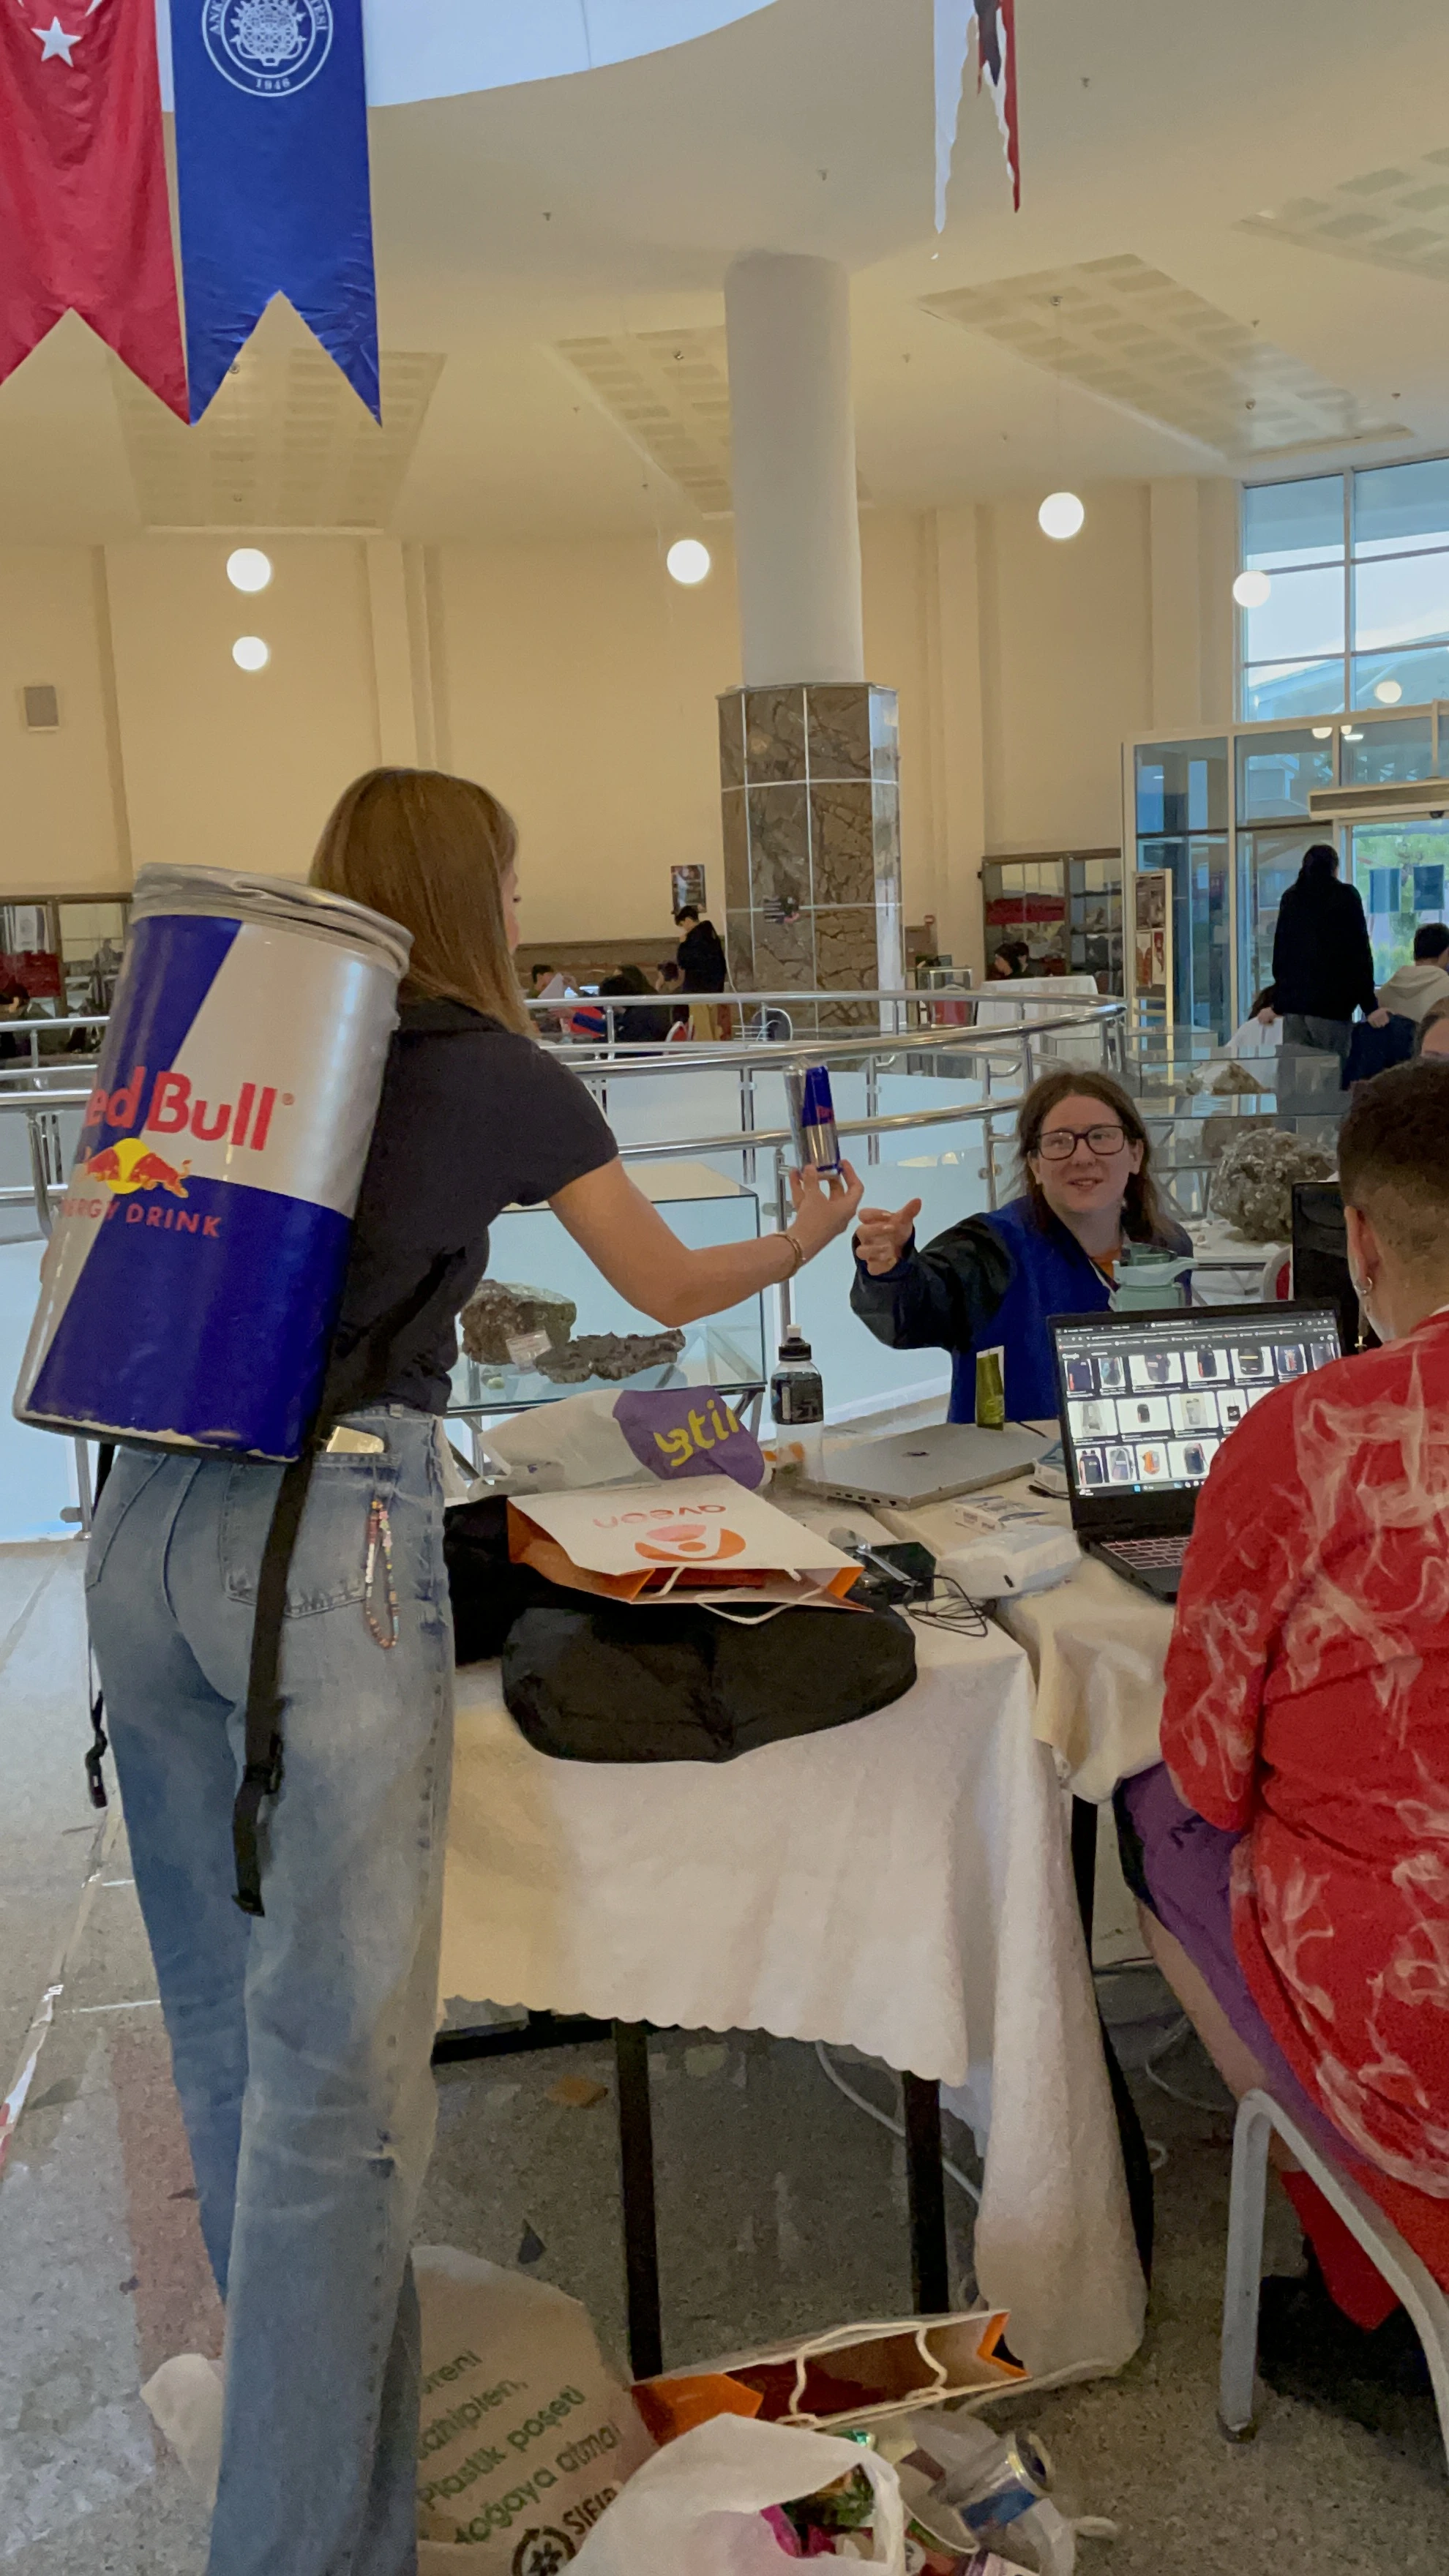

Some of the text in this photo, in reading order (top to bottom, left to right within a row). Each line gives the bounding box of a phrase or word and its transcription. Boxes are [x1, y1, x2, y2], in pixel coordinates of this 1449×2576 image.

[86, 1066, 277, 1151] ed Bull
[125, 1203, 222, 1238] DRINK
[416, 2384, 585, 2512] Plastik poşeti
